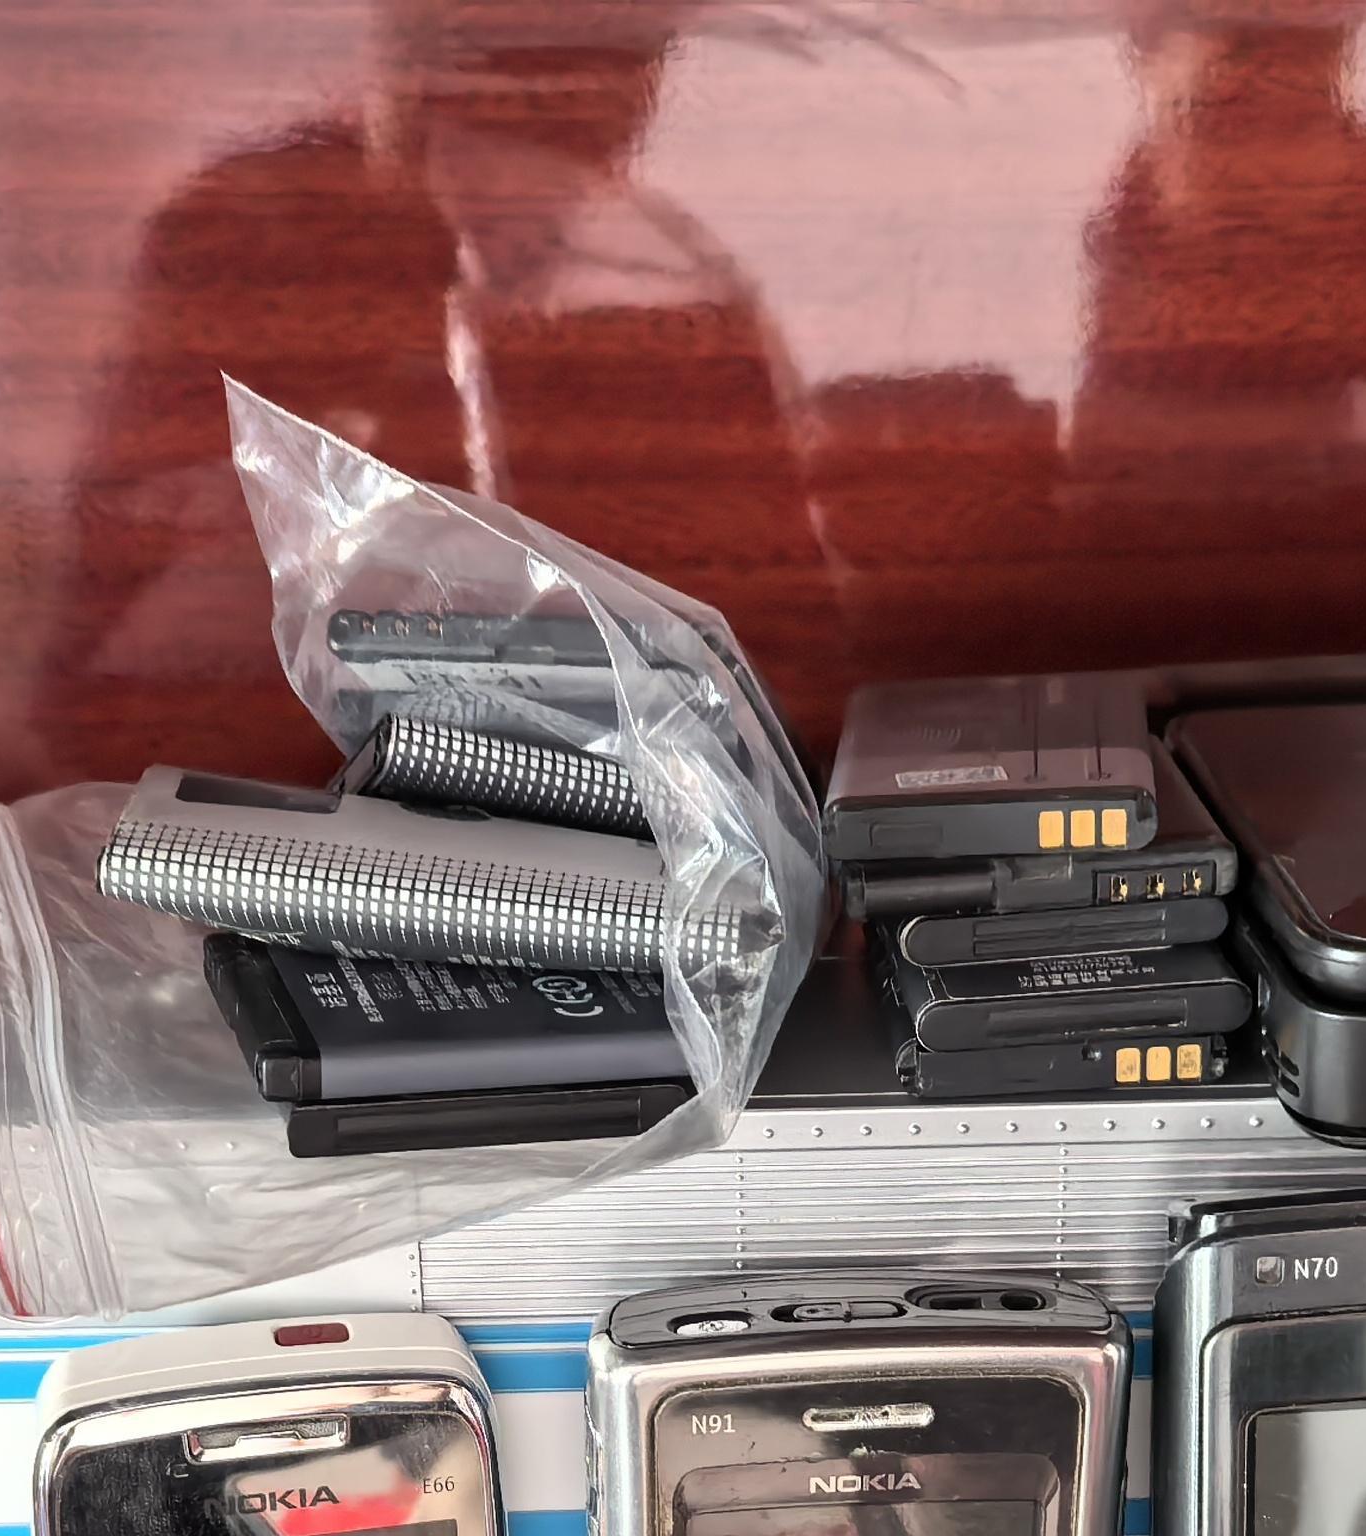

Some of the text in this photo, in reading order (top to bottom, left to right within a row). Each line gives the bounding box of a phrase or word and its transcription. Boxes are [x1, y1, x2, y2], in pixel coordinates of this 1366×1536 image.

[1293, 1256, 1338, 1280] N70
[692, 1414, 736, 1435] N91
[423, 1476, 456, 1495] E66
[809, 1472, 922, 1494] NOKIA
